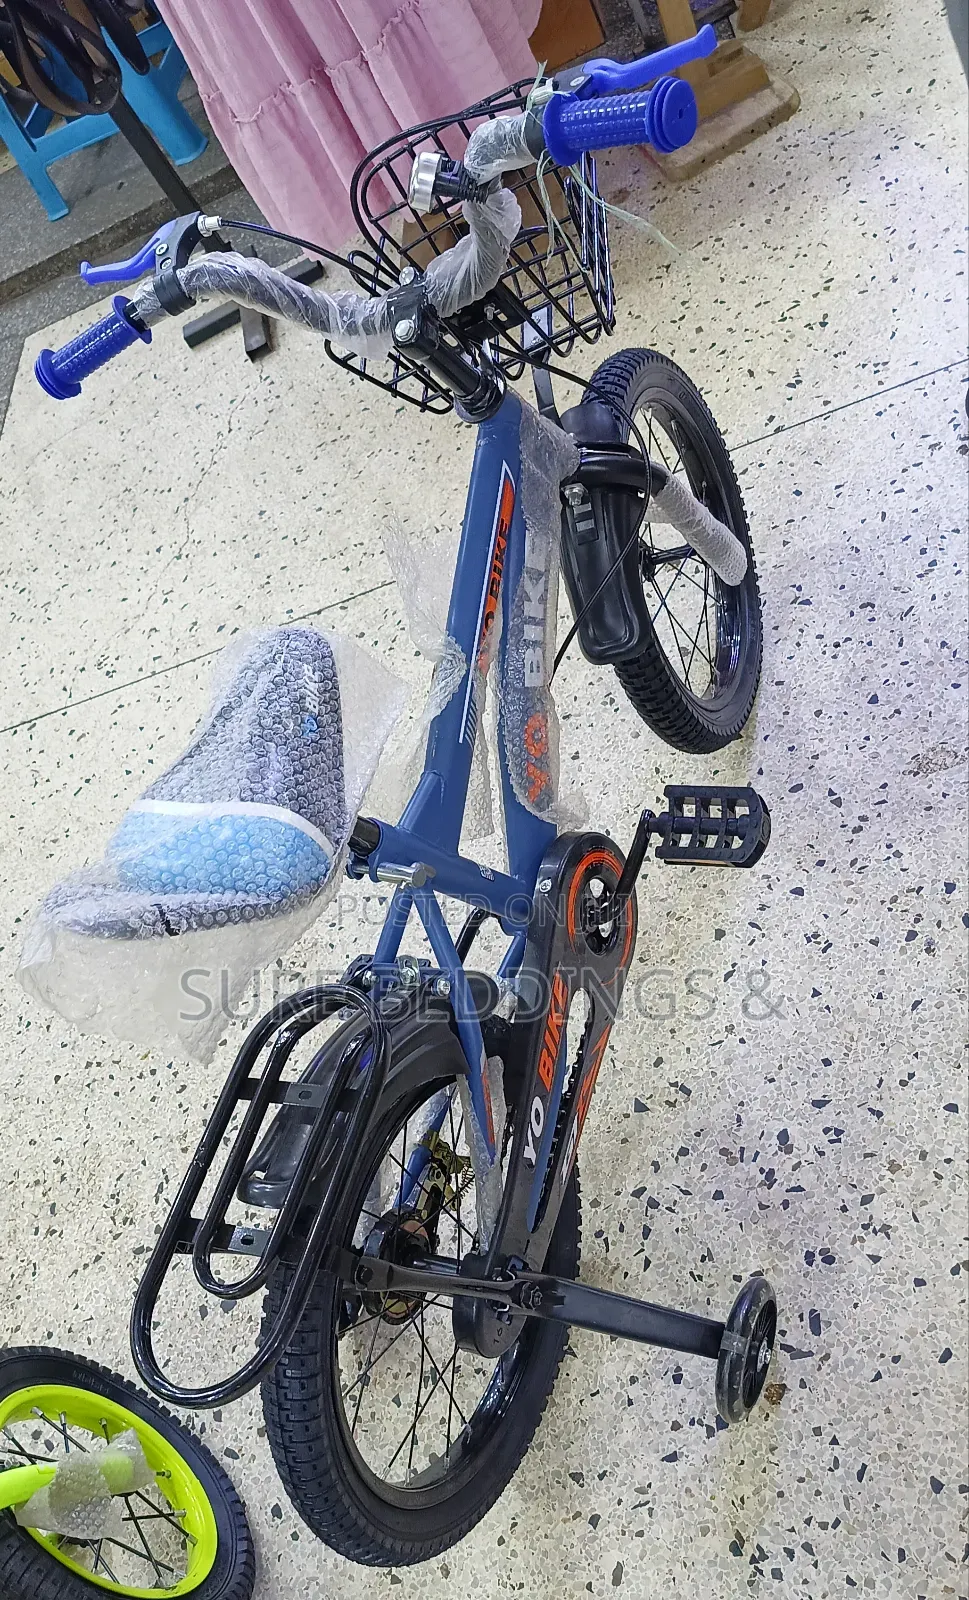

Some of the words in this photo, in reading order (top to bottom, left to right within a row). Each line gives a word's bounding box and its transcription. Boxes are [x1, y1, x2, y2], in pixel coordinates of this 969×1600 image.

[489, 518, 507, 600] BIKE
[526, 712, 548, 803] YO
[523, 1096, 544, 1166] YO
[538, 971, 568, 1092] BIKE
